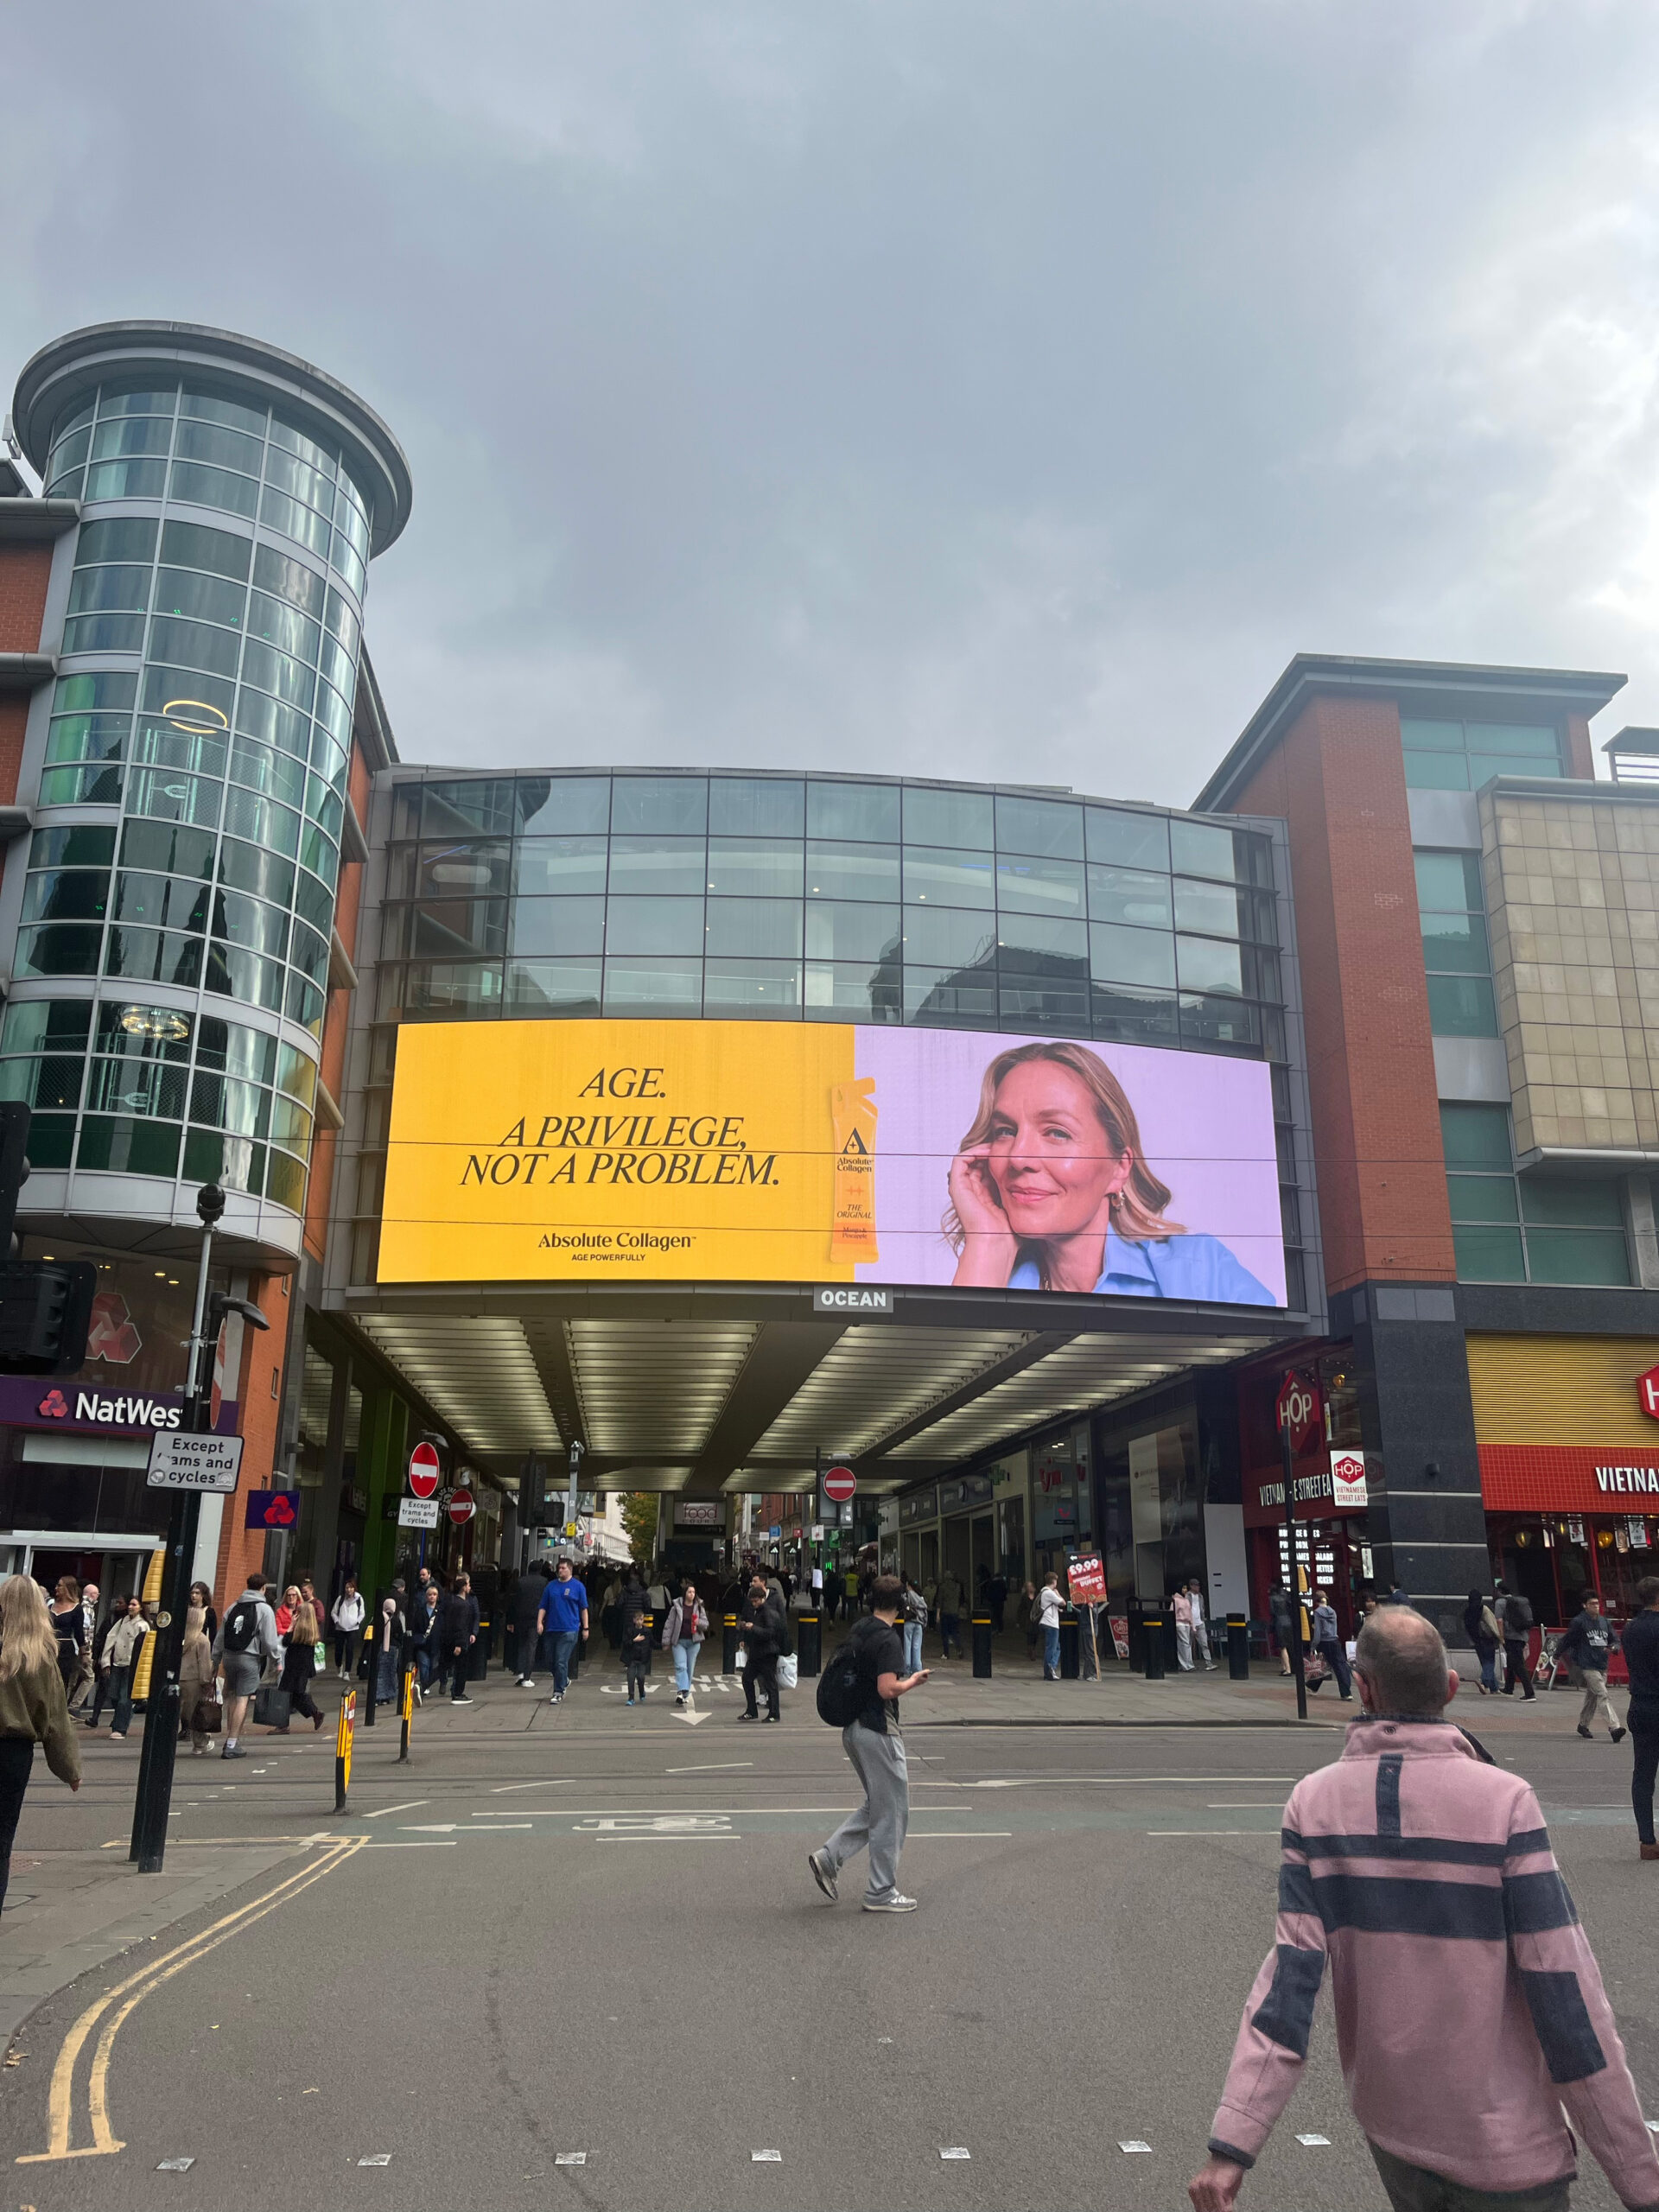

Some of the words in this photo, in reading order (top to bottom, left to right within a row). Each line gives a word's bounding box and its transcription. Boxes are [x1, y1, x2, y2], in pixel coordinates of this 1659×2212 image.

[577, 1067, 666, 1098] AGE.
[496, 1116, 526, 1147] A
[535, 1116, 747, 1152] PRIVILEGE,
[459, 1154, 549, 1185] NOT
[549, 1152, 576, 1184] A
[584, 1153, 779, 1185] PROBLEM.
[836, 1165, 872, 1173] Collagen
[836, 1211, 872, 1219] ORIGINAL
[537, 1232, 613, 1248] Absolute
[821, 1290, 887, 1307] OCEAN
[75, 1392, 183, 1427] NatWes
[172, 1438, 225, 1454] Except
[157, 1452, 200, 1467] ams
[206, 1458, 233, 1469] and
[168, 1471, 216, 1484] cycles
[1595, 1467, 1659, 1492] VIETNA
[1259, 1480, 1298, 1507] VIETNAME
[1299, 1474, 1322, 1501] STREET
[1322, 1473, 1332, 1497] EA
[408, 1501, 432, 1510] Except
[1069, 1558, 1099, 1575] £9.99
